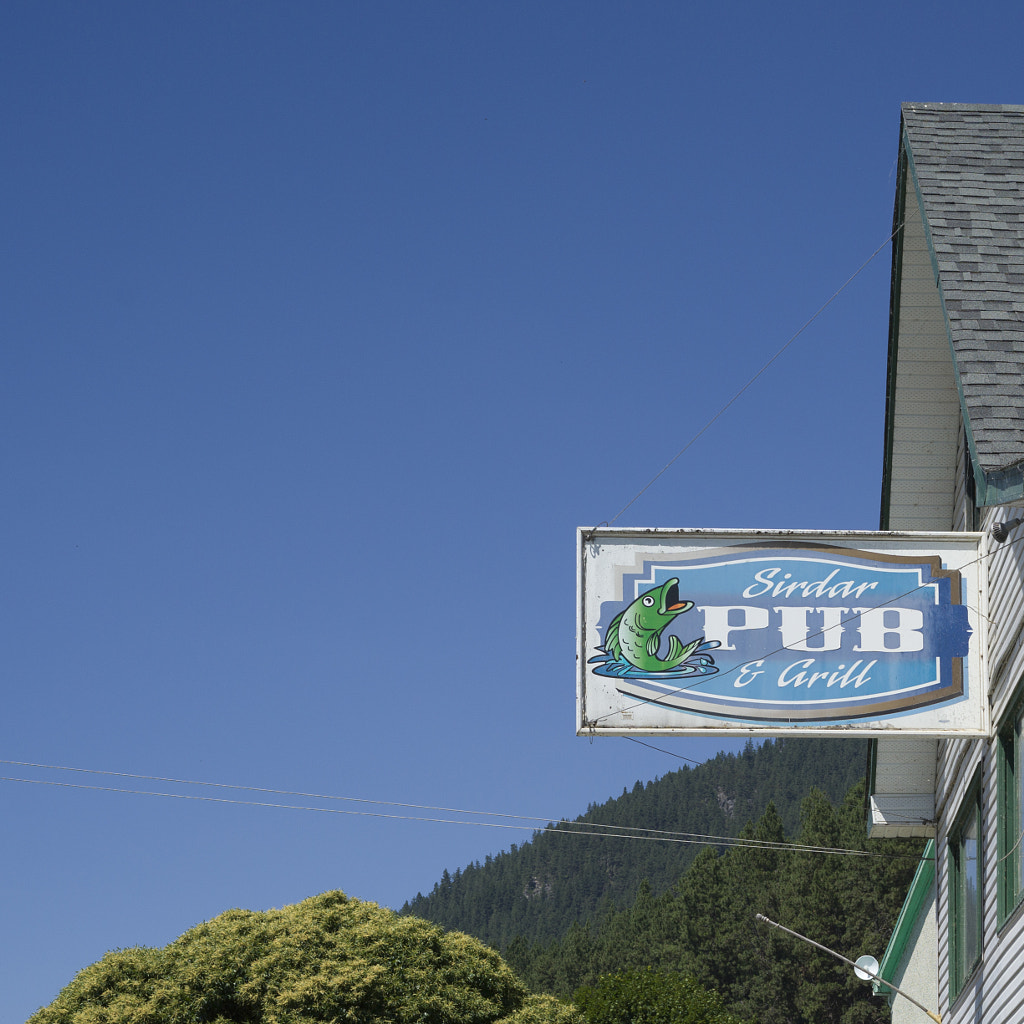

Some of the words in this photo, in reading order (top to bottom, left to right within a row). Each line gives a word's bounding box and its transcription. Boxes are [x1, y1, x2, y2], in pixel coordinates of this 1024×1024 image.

[742, 567, 879, 599] Sirdar
[697, 605, 924, 653] PUB
[733, 659, 765, 689] &
[777, 659, 878, 690] Grill
